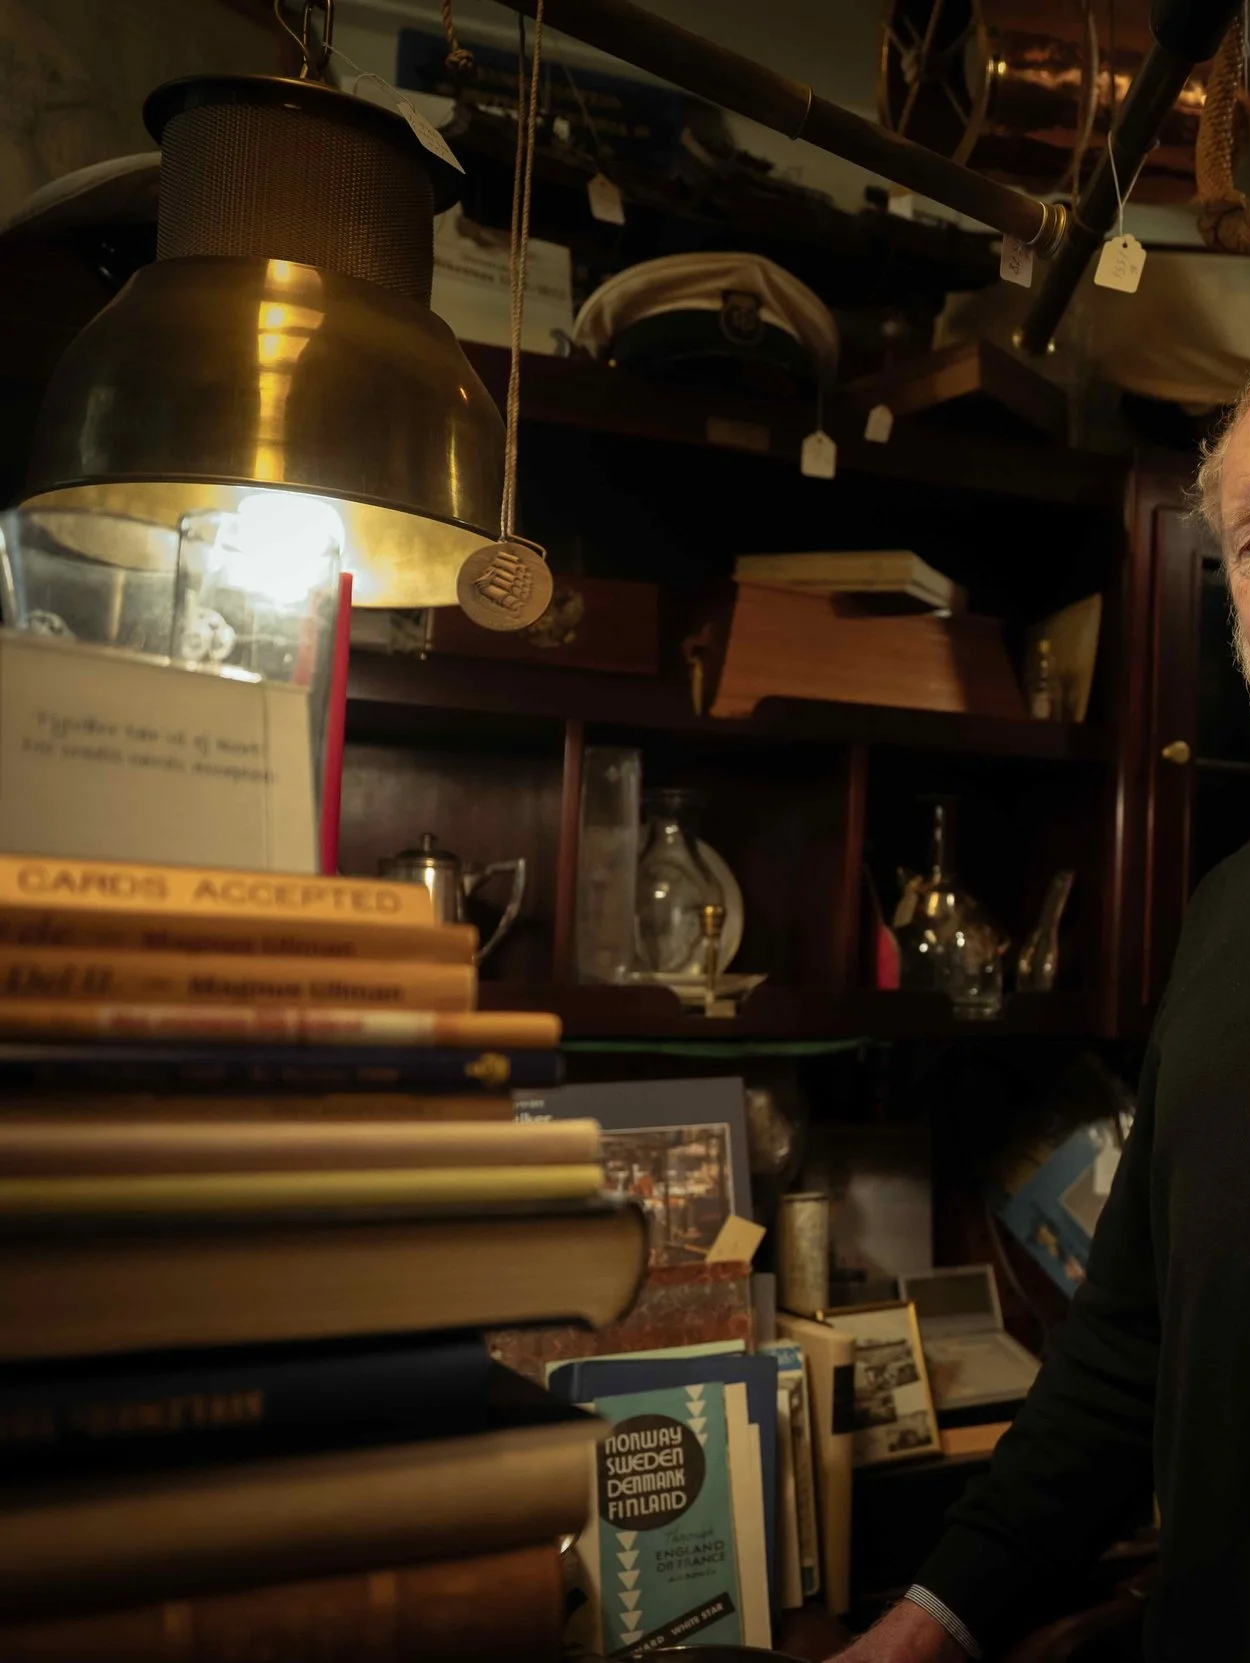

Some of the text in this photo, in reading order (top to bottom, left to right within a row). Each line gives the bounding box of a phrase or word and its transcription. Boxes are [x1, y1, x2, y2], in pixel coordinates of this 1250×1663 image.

[17, 864, 403, 915] CARDS ACCEPTED
[604, 1425, 682, 1455] NORWAY
[605, 1448, 685, 1476] SWEDEN
[607, 1468, 686, 1499] DENMARK
[608, 1490, 688, 1521] FINLAND
[655, 1540, 726, 1562] ENGLAND
[670, 1616, 701, 1636] WHITE
[700, 1602, 724, 1621] STAR
